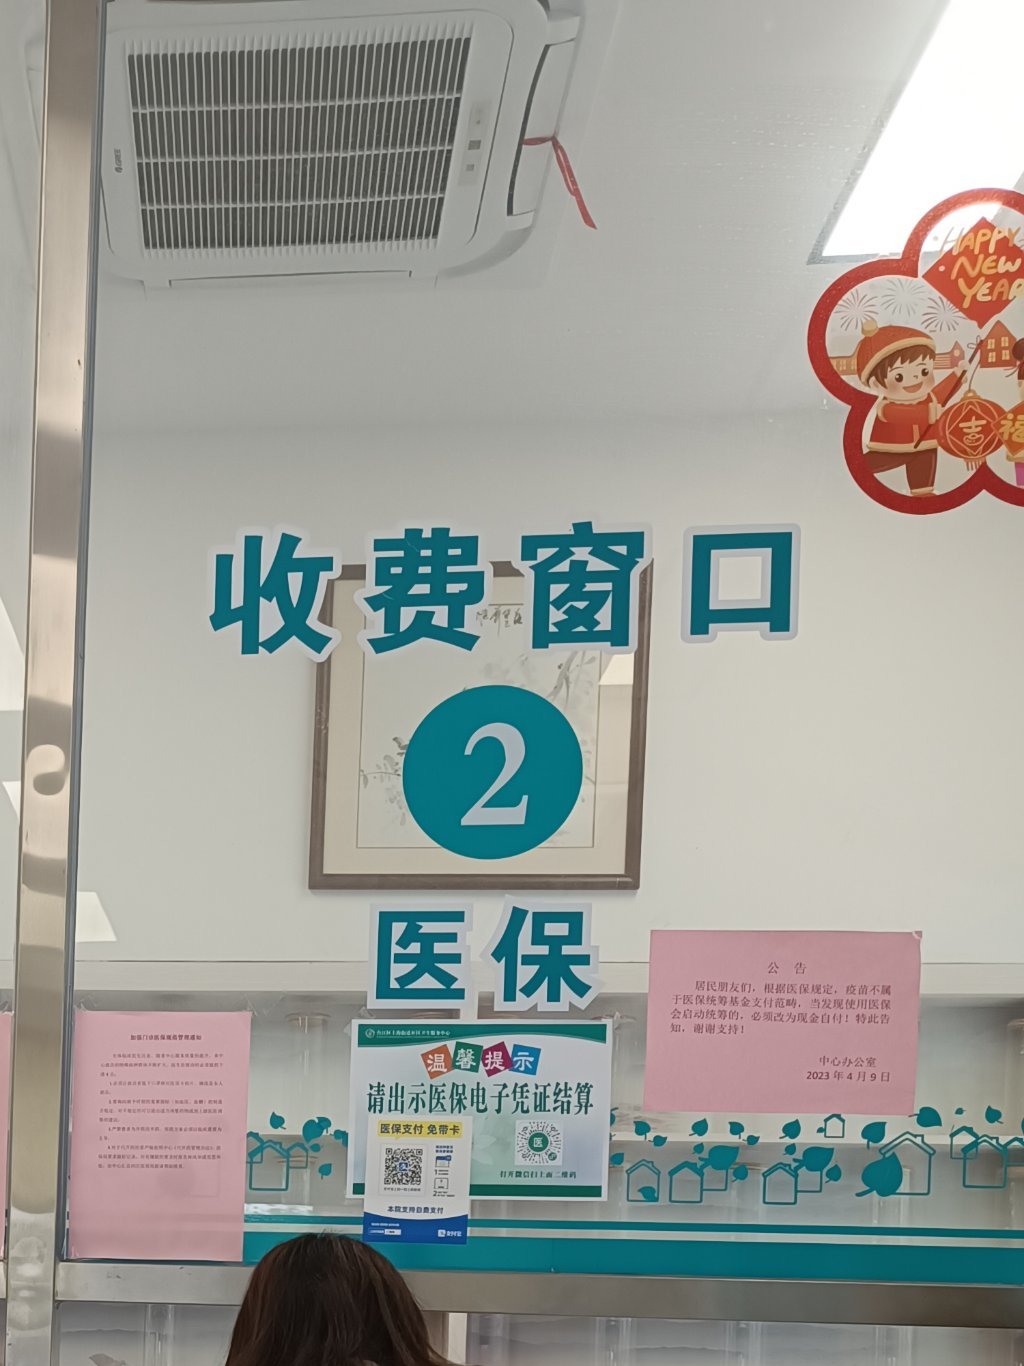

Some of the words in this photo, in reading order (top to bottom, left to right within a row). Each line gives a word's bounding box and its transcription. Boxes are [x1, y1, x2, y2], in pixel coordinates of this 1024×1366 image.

[940, 226, 1020, 255] HAPPY
[951, 254, 1022, 279] NEW
[208, 520, 794, 655] 收费窗口
[461, 721, 529, 825] 2
[374, 905, 593, 1003] 医保
[767, 961, 807, 975] 公告
[426, 1048, 534, 1073] 温馨提示
[819, 1055, 877, 1068] 中心办公室
[366, 1081, 594, 1116] 请出示医保电子凭证结算
[380, 1123, 423, 1135] 医保支付
[427, 1124, 461, 1136] 免带卡
